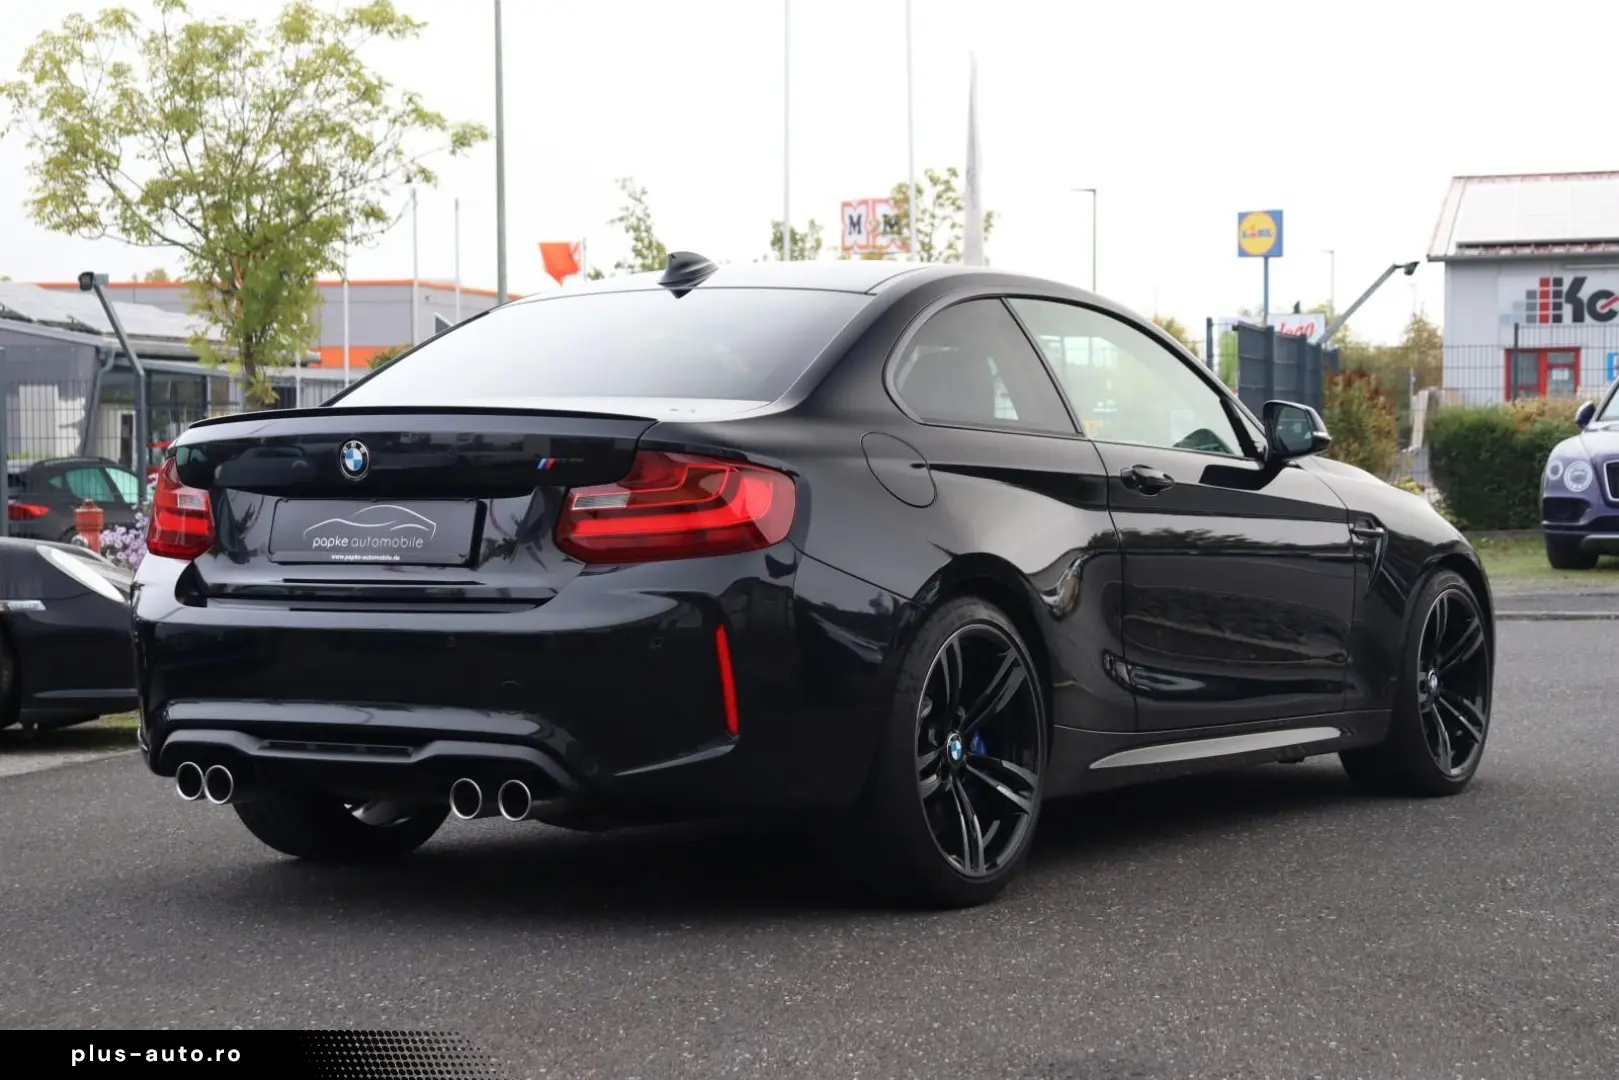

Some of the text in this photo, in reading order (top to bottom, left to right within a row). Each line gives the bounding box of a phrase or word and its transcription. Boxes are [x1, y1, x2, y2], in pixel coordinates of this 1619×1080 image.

[312, 535, 424, 549] papke automobile
[331, 553, 401, 562] www.papke-automobile.de
